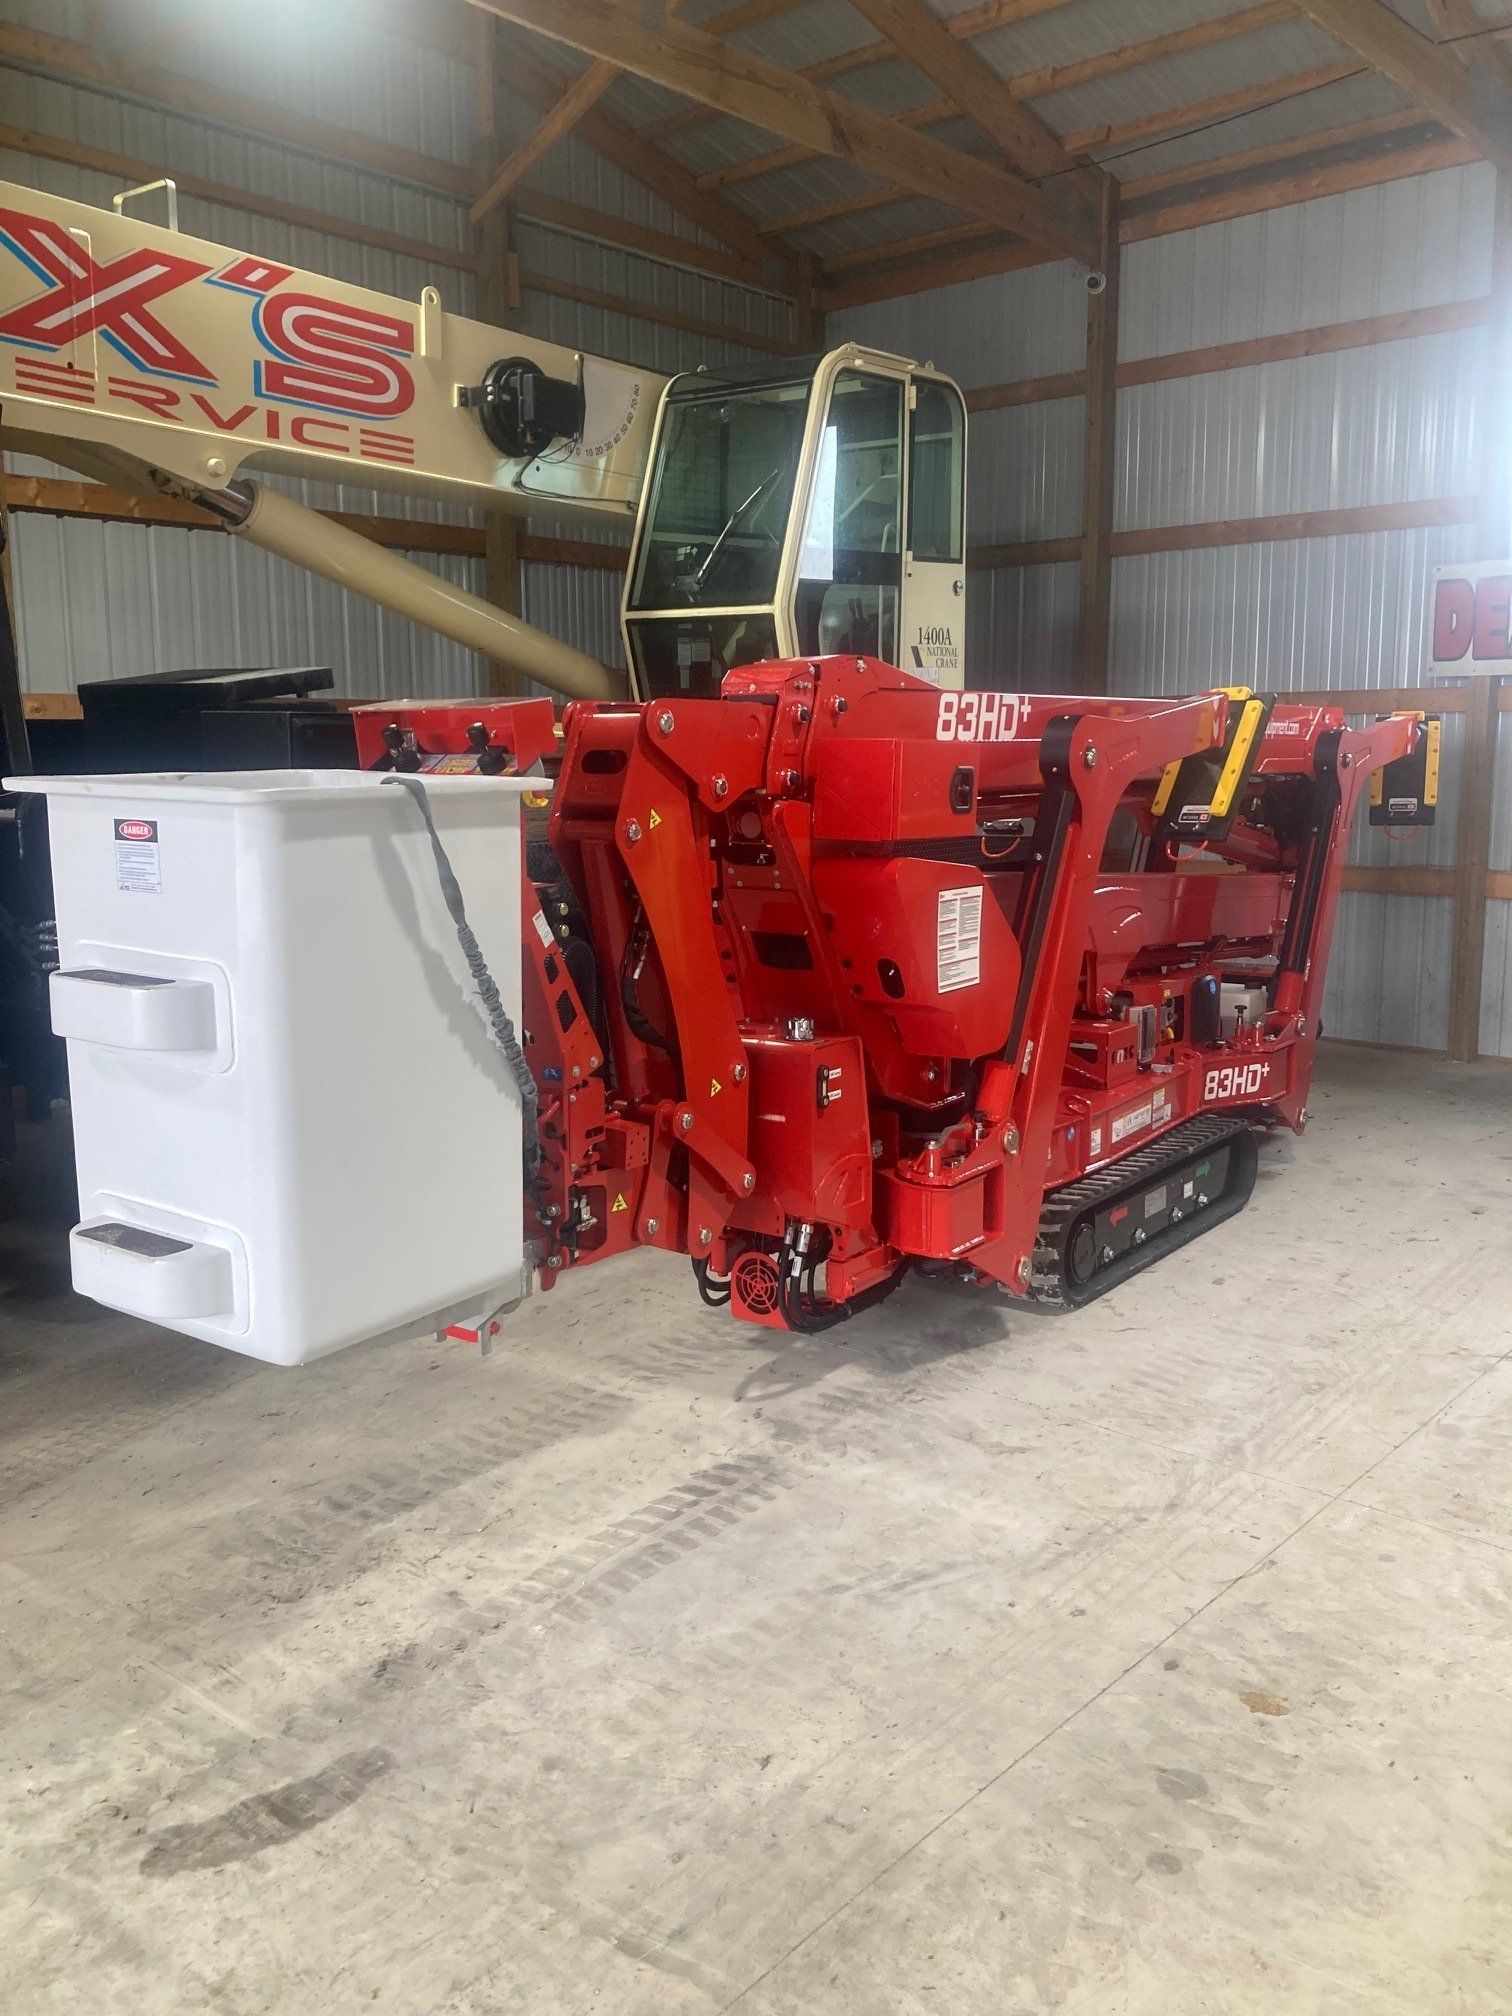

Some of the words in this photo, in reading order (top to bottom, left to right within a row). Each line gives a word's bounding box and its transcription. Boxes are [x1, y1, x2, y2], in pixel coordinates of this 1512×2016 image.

[15, 356, 414, 464] ERVICE
[585, 449, 594, 457] 10
[594, 446, 604, 456] 20
[604, 441, 613, 452] 30
[613, 433, 621, 445] 40
[620, 424, 628, 436] 50
[626, 412, 634, 425] 60
[630, 398, 638, 410] 70
[634, 384, 640, 397] 80
[918, 626, 952, 645] 1400A
[1433, 574, 1512, 662] DE
[927, 646, 959, 658] NATIONAL
[935, 657, 958, 669] CRANE
[936, 692, 1032, 742] 83HD+
[123, 825, 149, 836] DANGER
[1204, 1062, 1270, 1101] 83HD+
